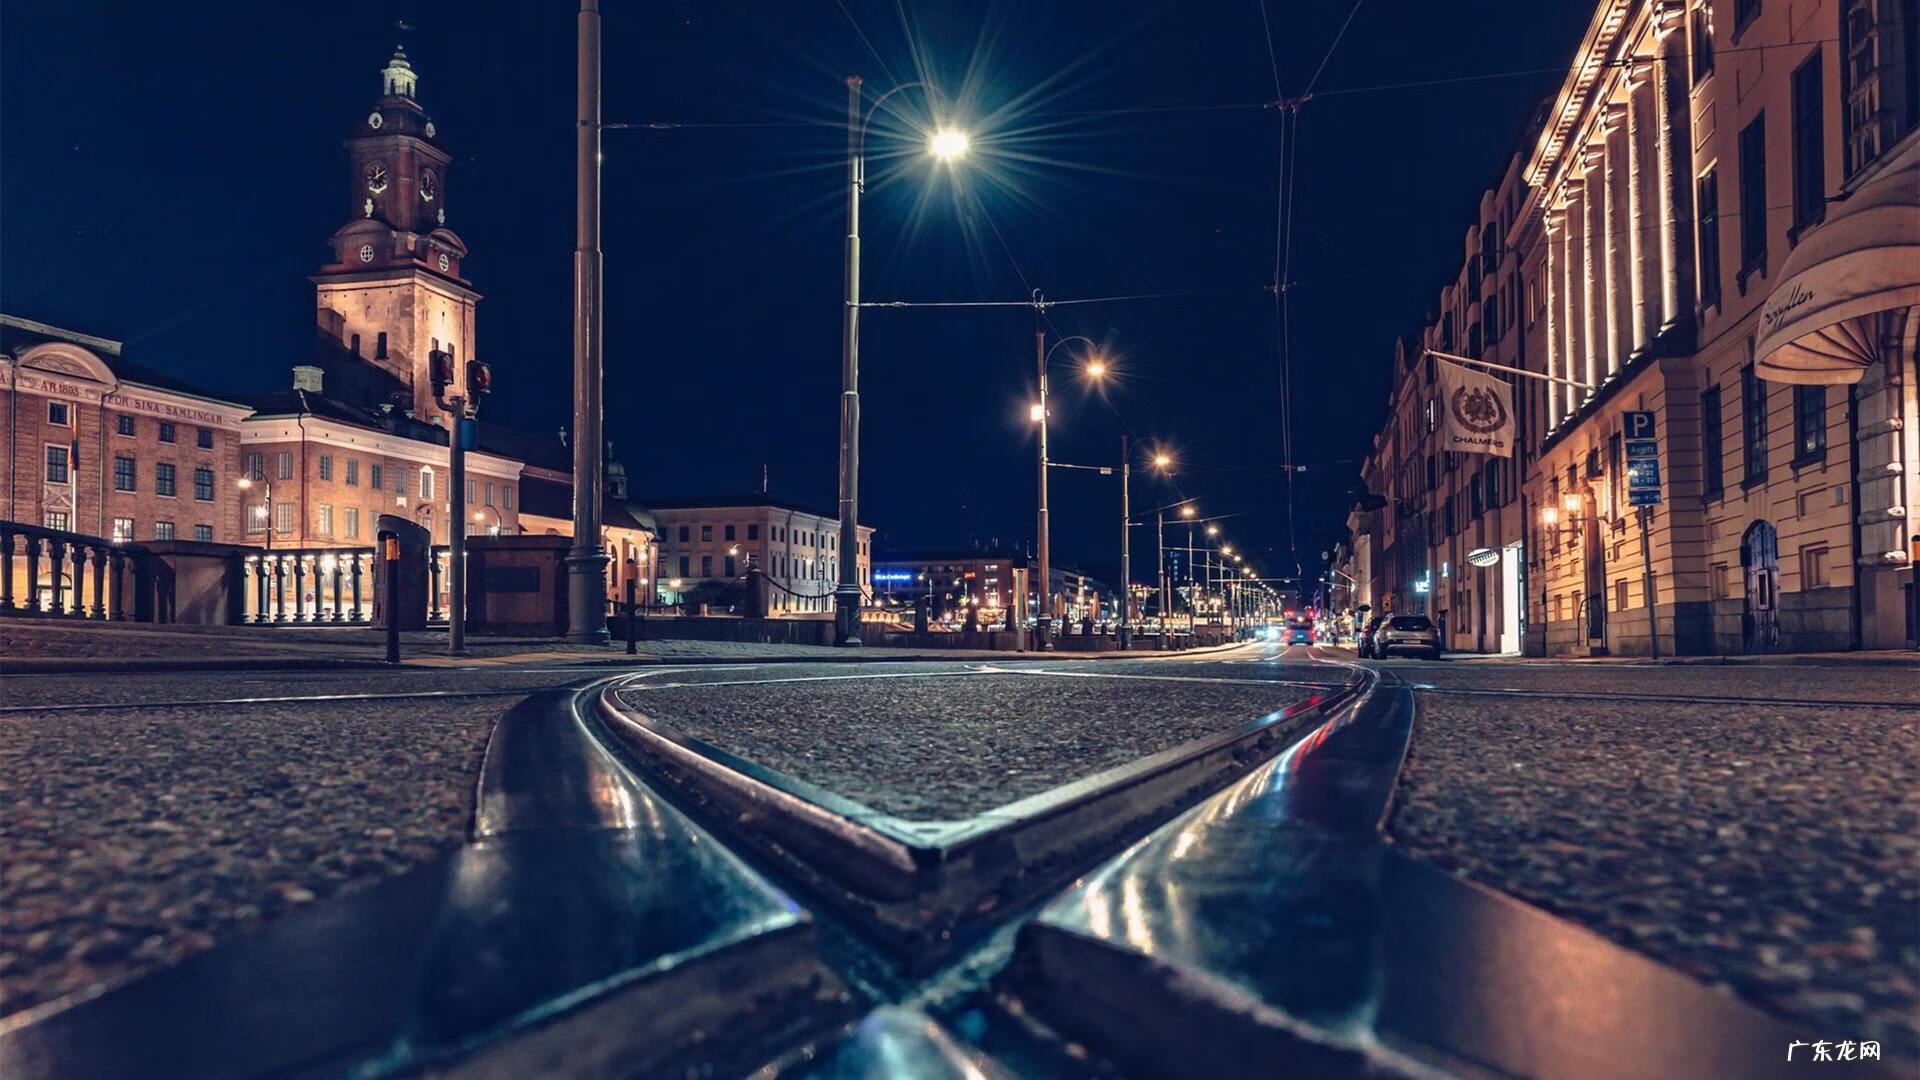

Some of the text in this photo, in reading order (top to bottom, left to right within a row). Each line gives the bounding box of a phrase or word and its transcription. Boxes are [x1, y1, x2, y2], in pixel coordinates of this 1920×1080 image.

[59, 385, 80, 397] 1895
[134, 400, 160, 413] SINA
[166, 408, 223, 423] SAMLINGAR
[1633, 414, 1648, 437] P
[1453, 436, 1504, 448] CHALMERS
